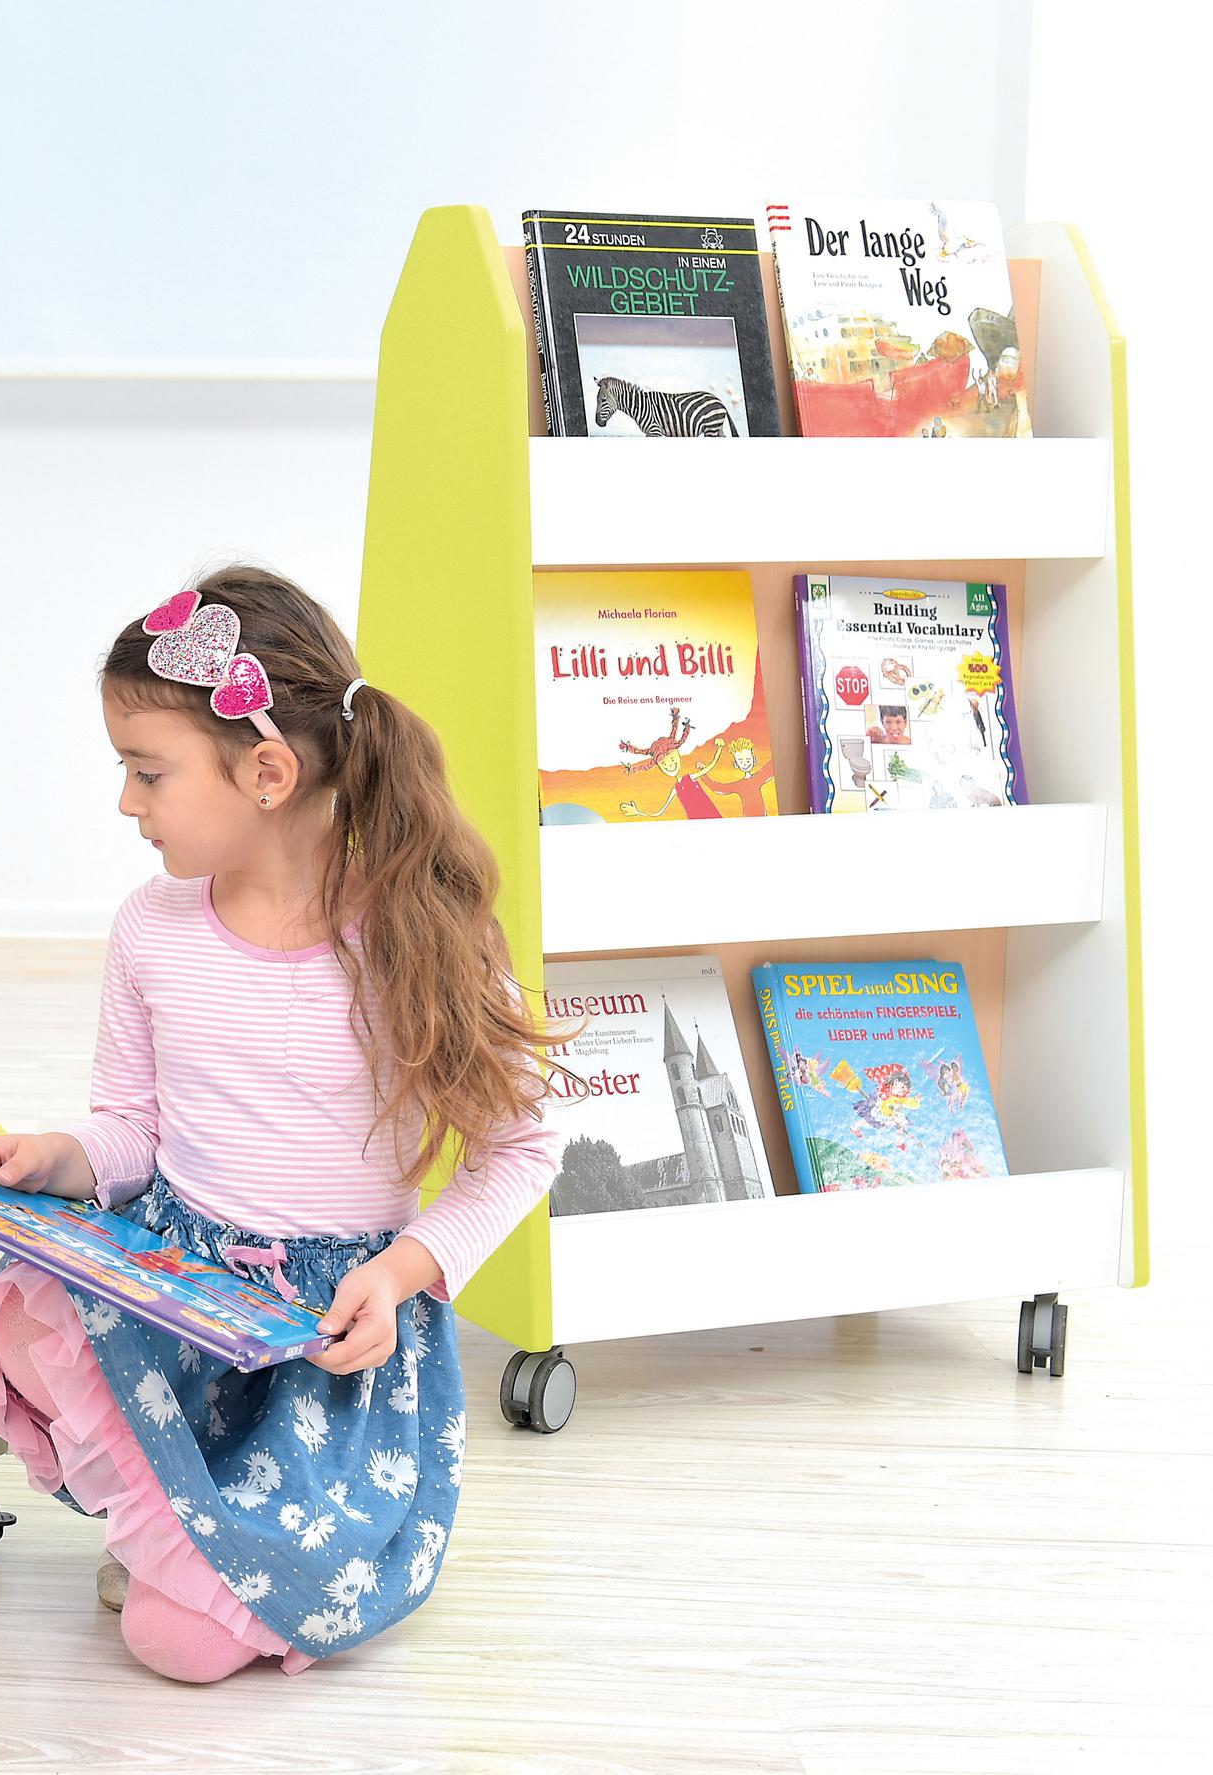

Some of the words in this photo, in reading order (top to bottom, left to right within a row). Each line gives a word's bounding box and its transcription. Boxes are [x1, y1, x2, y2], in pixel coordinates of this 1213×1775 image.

[564, 224, 590, 244] 24
[592, 234, 646, 246] STUNDEN
[804, 217, 850, 256] Der
[859, 219, 926, 267] lange
[678, 257, 690, 268] IN
[692, 257, 727, 269] EINEM
[566, 265, 734, 292] WILDSCHUTZ-
[899, 268, 951, 316] Weg
[610, 291, 699, 315] GEBIET
[972, 594, 985, 602] All
[598, 608, 642, 620] Michaela
[644, 608, 677, 619] Florian
[874, 602, 937, 620] Building
[970, 602, 989, 612] Ages
[906, 622, 984, 640] Vocabulary
[550, 645, 608, 678] Lilli
[617, 644, 669, 677] und
[676, 643, 734, 676] Billi
[837, 677, 868, 694] STOP
[603, 697, 616, 705] Die
[618, 696, 638, 705] Reise
[655, 696, 692, 706] Bergmeer
[783, 974, 864, 997] SPIEL
[865, 980, 895, 995] und
[896, 972, 959, 995] SING
[759, 987, 778, 1029] SING
[795, 1008, 813, 1020] die
[817, 1005, 874, 1019] schönsten
[876, 1005, 962, 1019] FINGERSPIELE,
[573, 1039, 593, 1047] Kloster
[613, 1037, 632, 1046] Lieben
[594, 1029, 637, 1038] Kunstmuseum
[828, 1028, 868, 1041] LIEDER
[872, 1028, 894, 1040] und
[897, 1028, 935, 1039] REIME
[574, 1048, 609, 1057] Magdeburg
